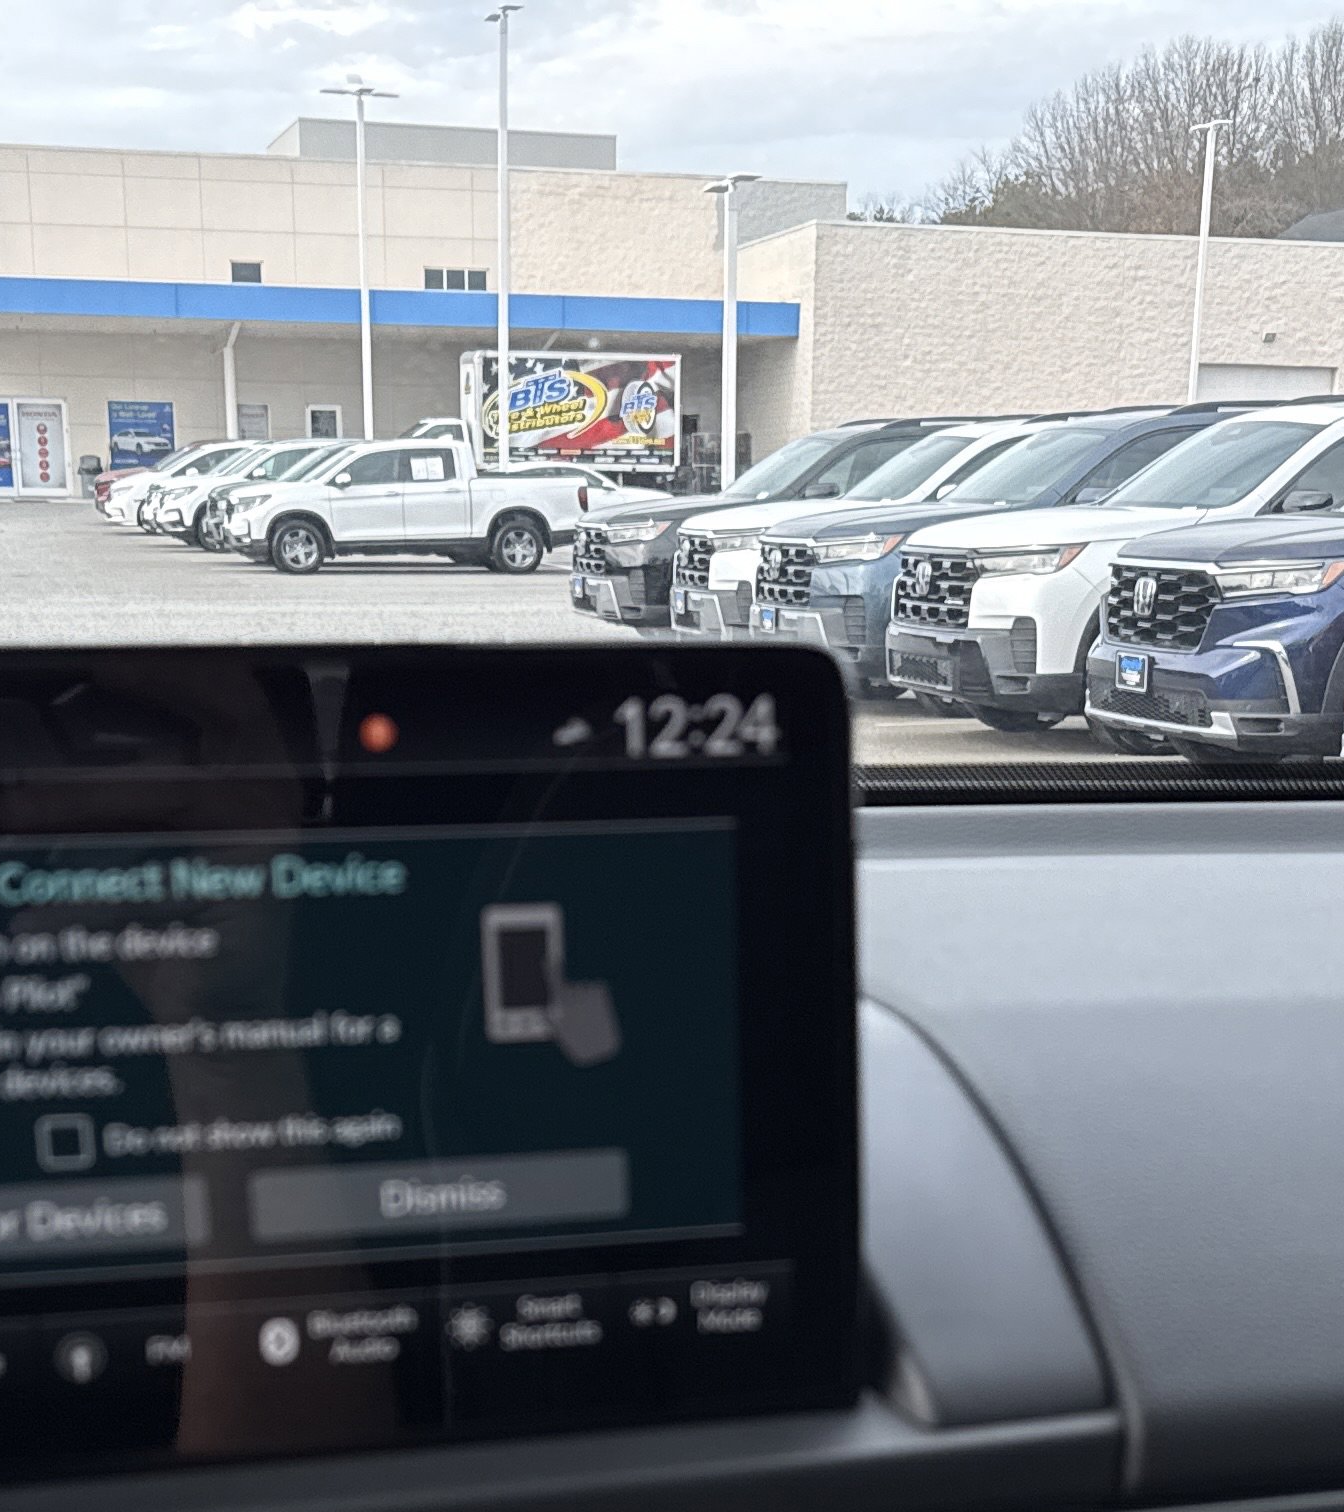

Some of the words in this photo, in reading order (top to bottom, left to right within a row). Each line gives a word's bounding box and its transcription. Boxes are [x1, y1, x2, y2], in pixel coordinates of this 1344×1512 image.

[509, 371, 570, 411] BTS
[539, 400, 585, 414] Wheel
[494, 412, 585, 432] stributors
[613, 693, 780, 759] 12:24
[170, 857, 267, 900] New
[271, 852, 408, 898] Device
[11, 932, 56, 964] on
[58, 925, 114, 963] the
[115, 922, 221, 960] device
[23, 1027, 97, 1065] your
[97, 1016, 219, 1058] owner's
[219, 1010, 328, 1050] manual
[329, 1009, 376, 1048] for
[376, 1013, 402, 1045] a
[103, 1122, 152, 1158] Do
[153, 1120, 204, 1153] not
[205, 1115, 277, 1150] show
[277, 1111, 329, 1147] this
[329, 1108, 402, 1147] again
[380, 1175, 507, 1219] Dismiss
[25, 1197, 168, 1243] Devices
